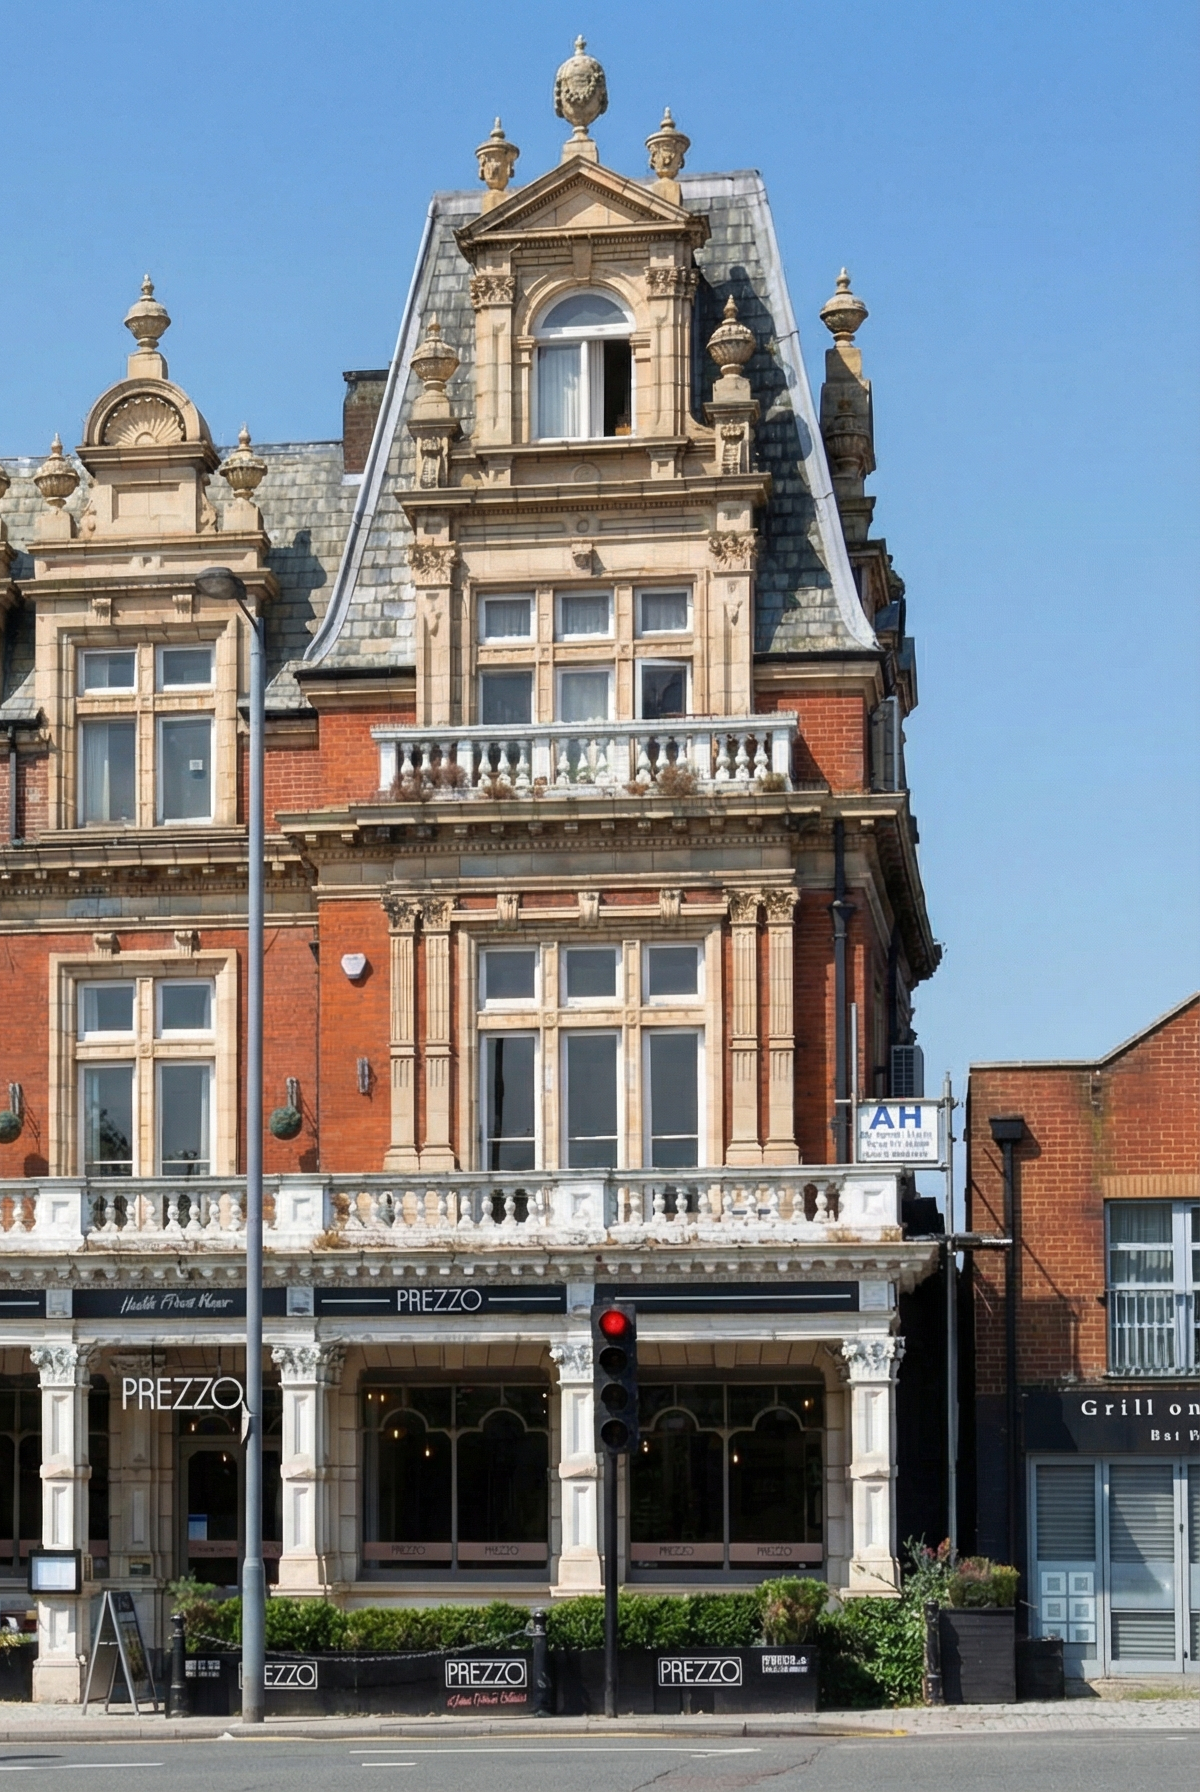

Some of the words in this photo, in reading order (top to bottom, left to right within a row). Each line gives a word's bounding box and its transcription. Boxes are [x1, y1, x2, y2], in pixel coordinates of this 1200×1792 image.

[869, 1105, 921, 1129] AH
[397, 1288, 482, 1311] PREZZO
[122, 1376, 243, 1410] PREZZO
[1081, 1398, 1154, 1416] Grill
[264, 1664, 315, 1686] EZZO
[448, 1662, 524, 1685] PREZZO
[660, 1660, 740, 1683] PREZZO
